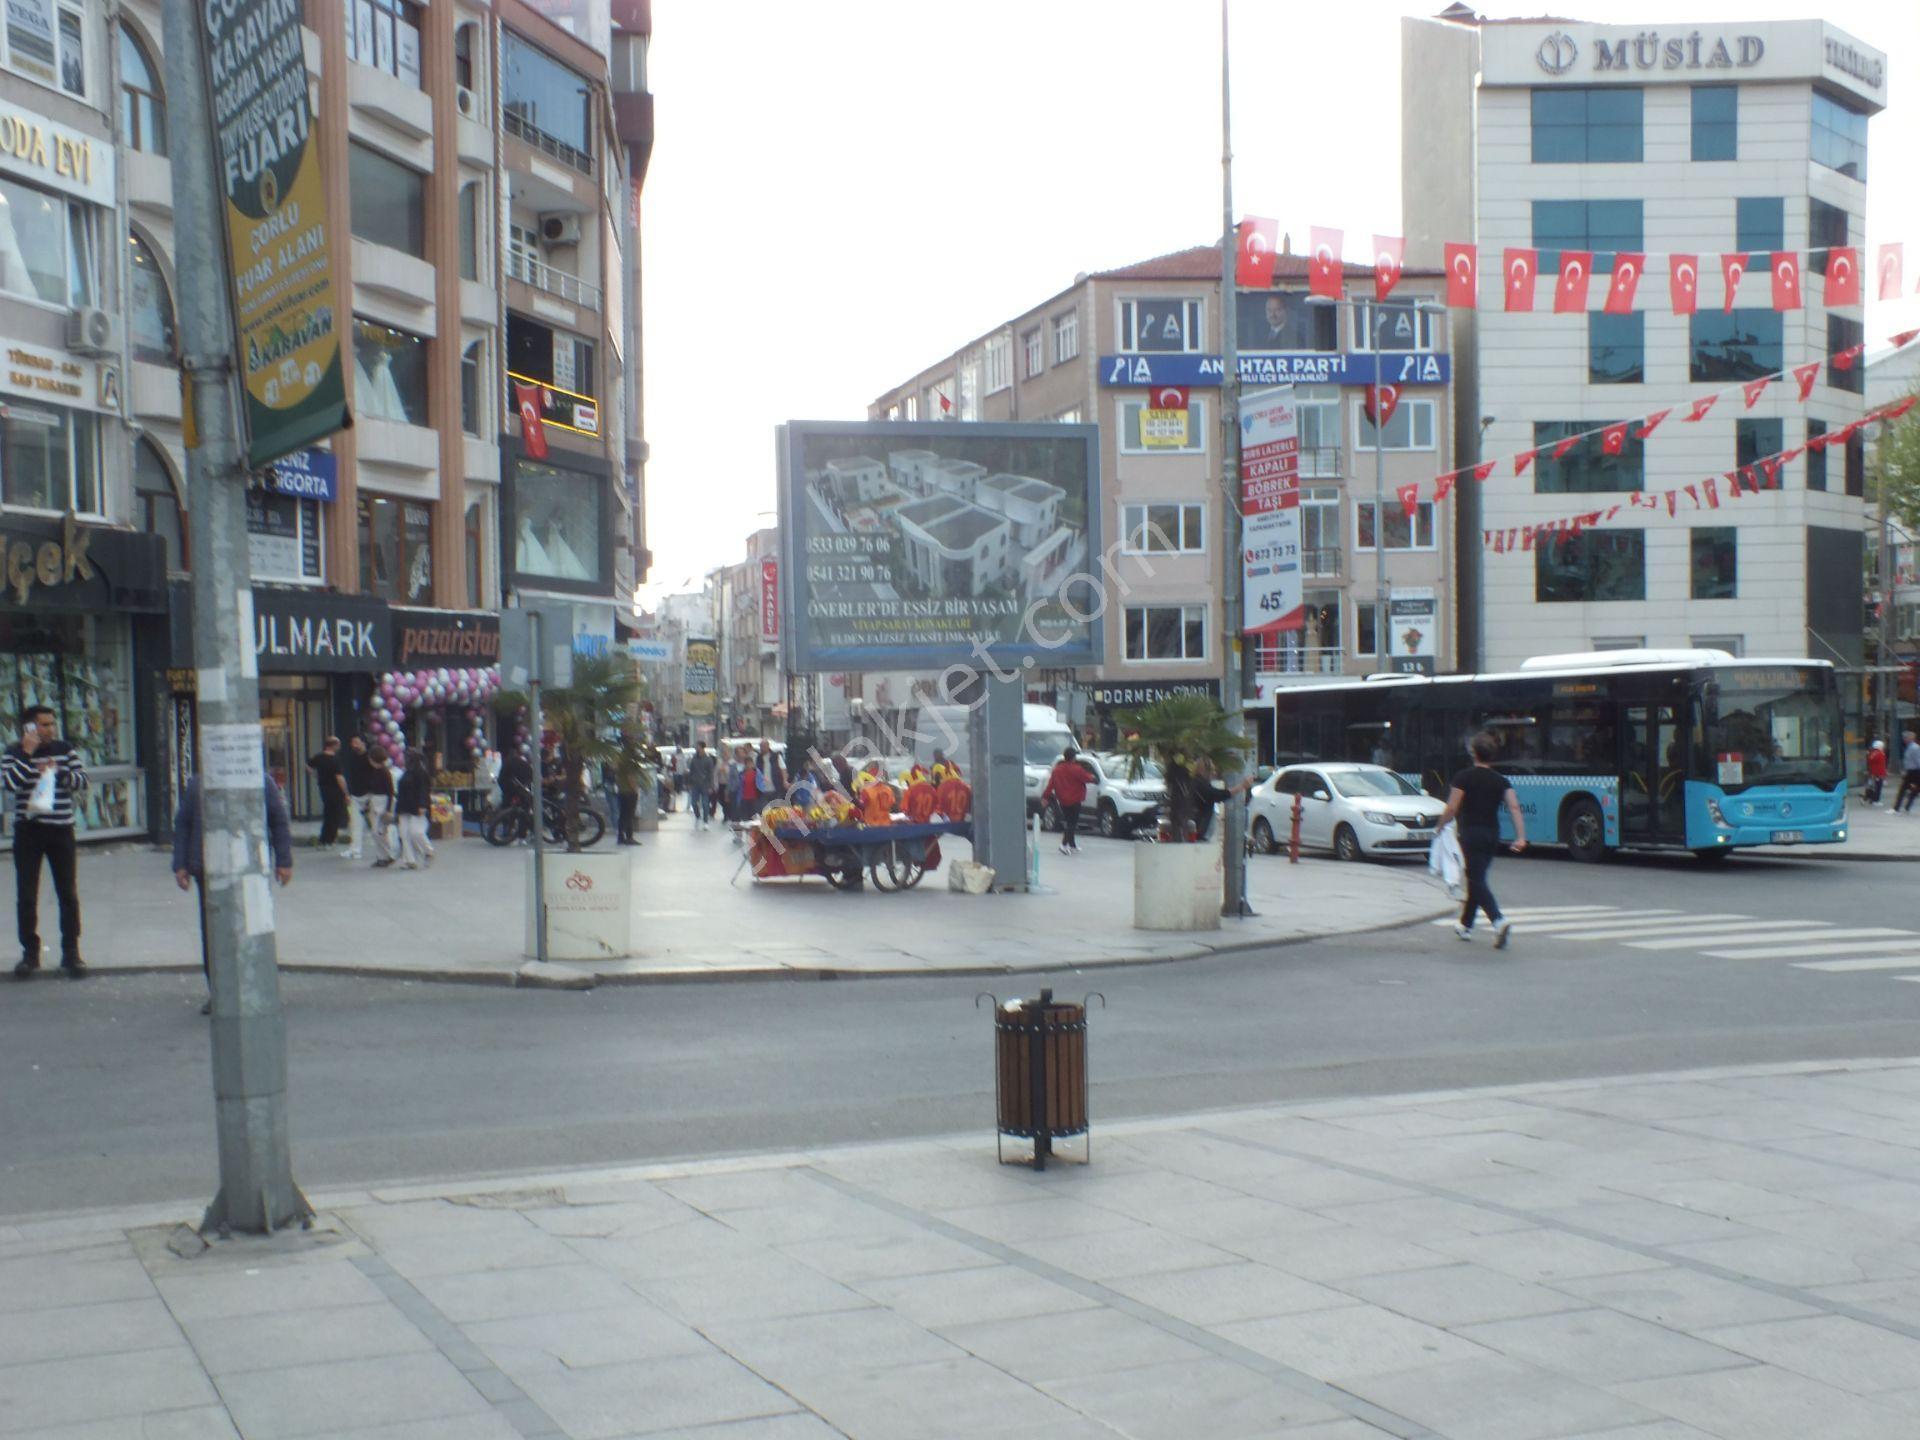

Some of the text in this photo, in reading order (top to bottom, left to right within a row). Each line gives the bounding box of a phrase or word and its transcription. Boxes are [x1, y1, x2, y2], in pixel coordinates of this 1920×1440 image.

[210, 0, 296, 88] KARAVAN
[1593, 31, 1765, 71] MÜSİAD
[223, 97, 308, 197] FUARI
[54, 132, 92, 186] EVİ
[249, 202, 299, 256] ÇORLU
[236, 256, 273, 299] FUAR
[278, 223, 325, 272] ALANI
[1199, 354, 1346, 374] ANHTAR PARTİ
[272, 452, 311, 471] ENİZ
[1250, 458, 1288, 477] KAPALI
[1248, 475, 1291, 498] BÖBREK
[1257, 495, 1282, 512] TAŞI
[860, 536, 874, 553] 76
[876, 536, 890, 553] 06
[1273, 546, 1283, 558] 73
[1285, 544, 1296, 556] 73
[838, 564, 857, 581] 321
[860, 564, 875, 581] 90
[877, 564, 892, 581] 76
[808, 598, 1019, 618] ÖNERLER'DE EŞSİZ BİR YAŞAM
[1103, 688, 1163, 704] DORMEN
